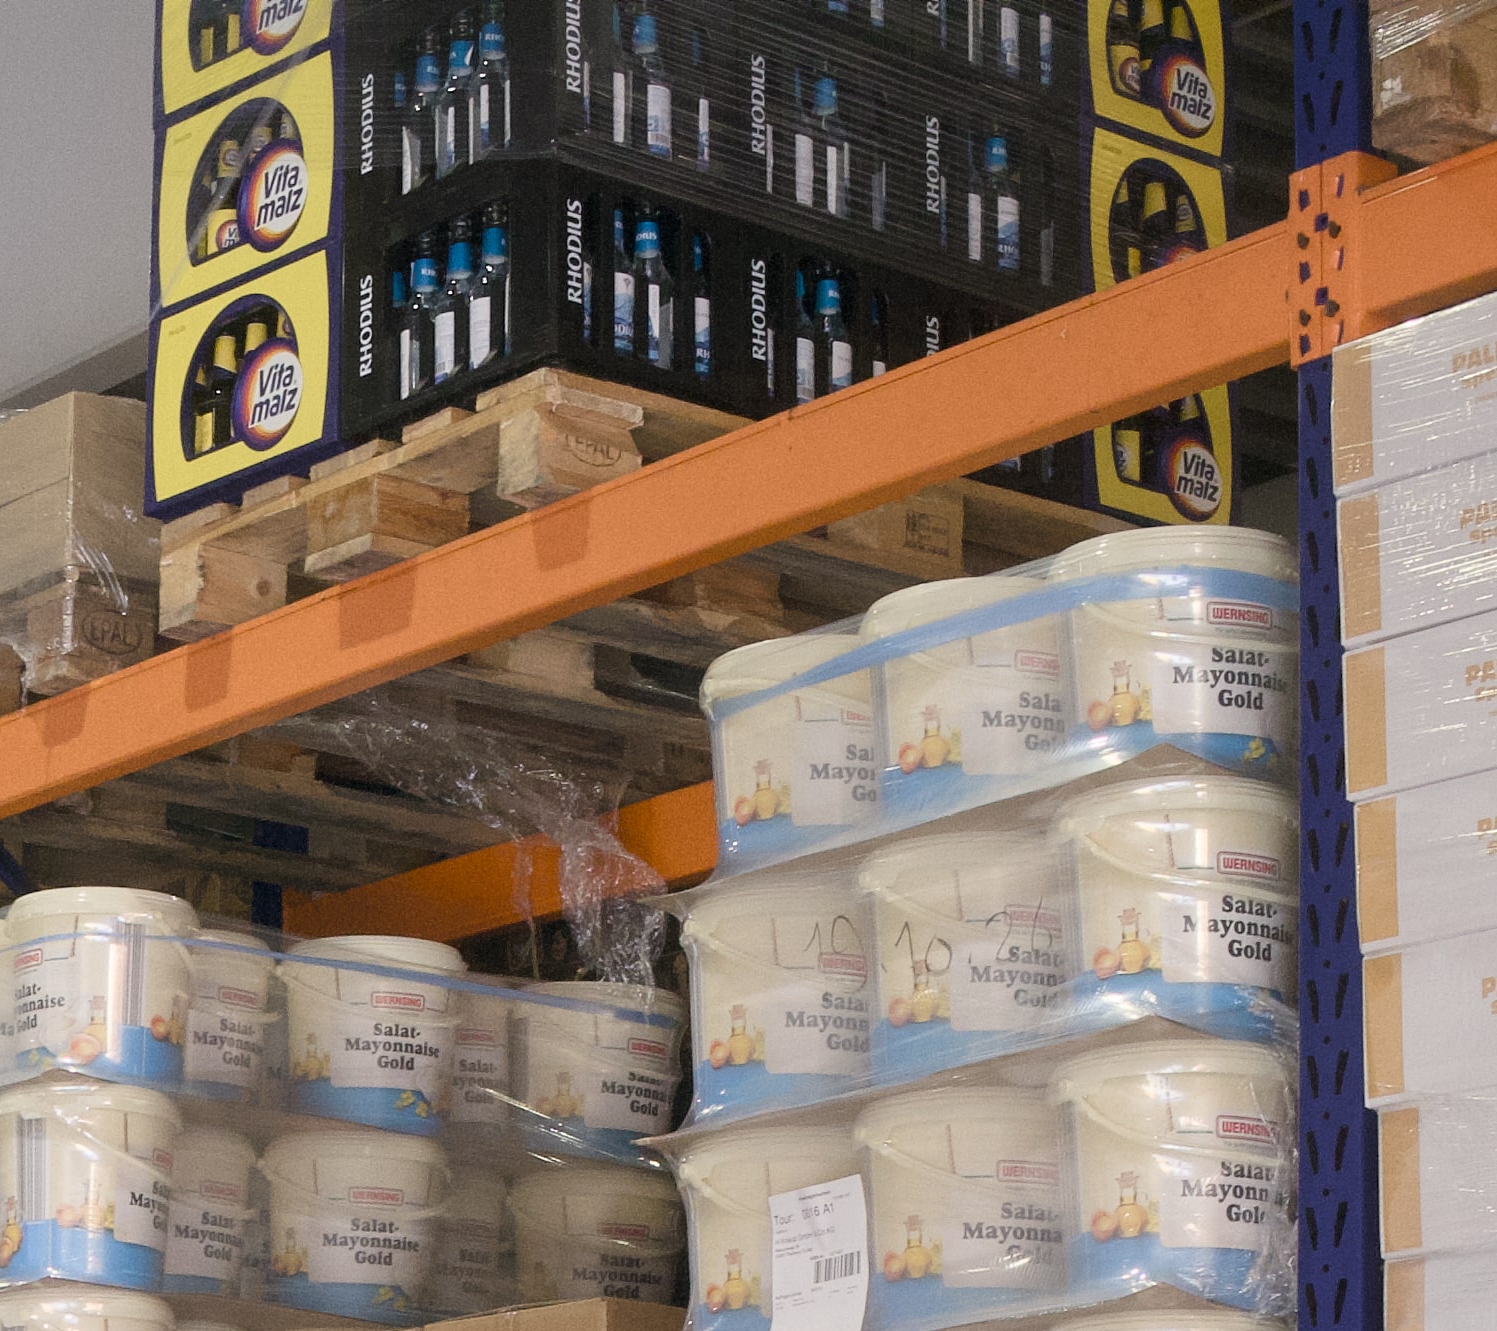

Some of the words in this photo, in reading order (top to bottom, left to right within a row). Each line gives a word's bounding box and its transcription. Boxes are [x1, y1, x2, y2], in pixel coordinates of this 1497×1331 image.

[1176, 70, 1208, 100] Vita
[751, 54, 765, 156] RHODIUS
[1168, 92, 1212, 121] malz
[360, 73, 374, 176] RHODIUS
[926, 114, 940, 215] RHODIUS
[263, 164, 299, 199] Vita
[255, 191, 302, 232] malz
[566, 198, 583, 305] RHODIUS
[751, 258, 766, 361] RHODIUS
[359, 273, 373, 377] RHODIUS
[258, 362, 295, 396] Vita
[250, 388, 297, 428] malz
[1182, 452, 1216, 482] Vita
[1175, 474, 1220, 502] malz
[1209, 605, 1272, 625] WERNSING
[1211, 646, 1270, 665] Salat-
[1217, 689, 1265, 712] Gold
[1222, 896, 1278, 919] Salat-
[1227, 940, 1273, 963] Gold
[373, 1023, 421, 1040] Salat-
[344, 1037, 440, 1059] Mayonnaise
[377, 1055, 415, 1072] Gold
[350, 1218, 399, 1235] Salat-
[322, 1233, 420, 1253] Mayonnaise
[354, 1251, 393, 1268] Gold
